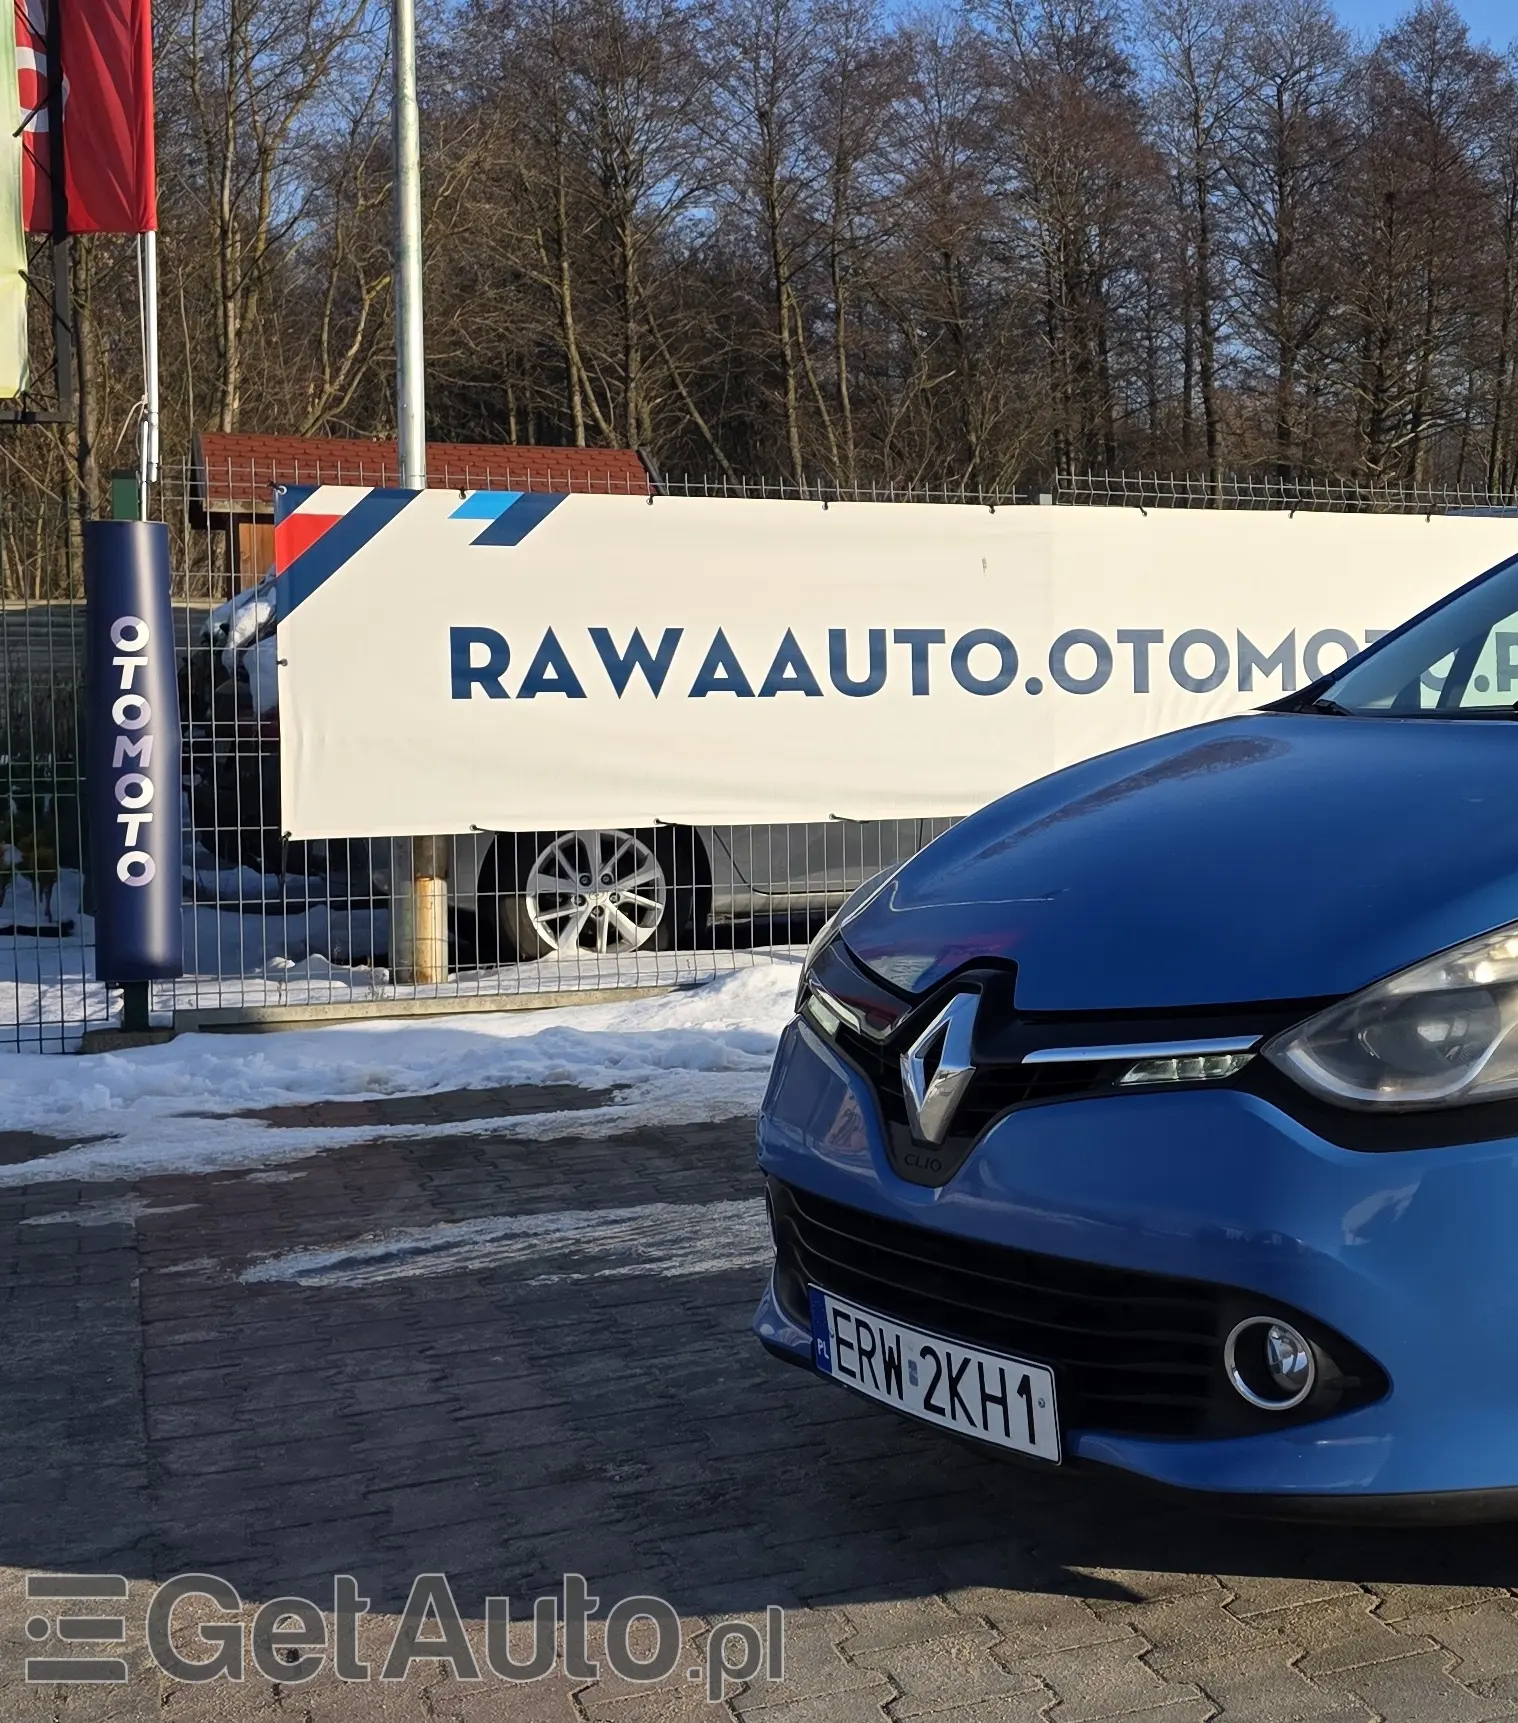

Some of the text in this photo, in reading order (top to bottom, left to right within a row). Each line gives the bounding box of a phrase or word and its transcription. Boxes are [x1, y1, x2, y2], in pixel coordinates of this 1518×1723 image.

[109, 615, 156, 887] OTOMOTO
[904, 1153, 943, 1173] CLIO
[817, 1338, 829, 1359] PL
[832, 1306, 1036, 1445] ERW 2KH1
